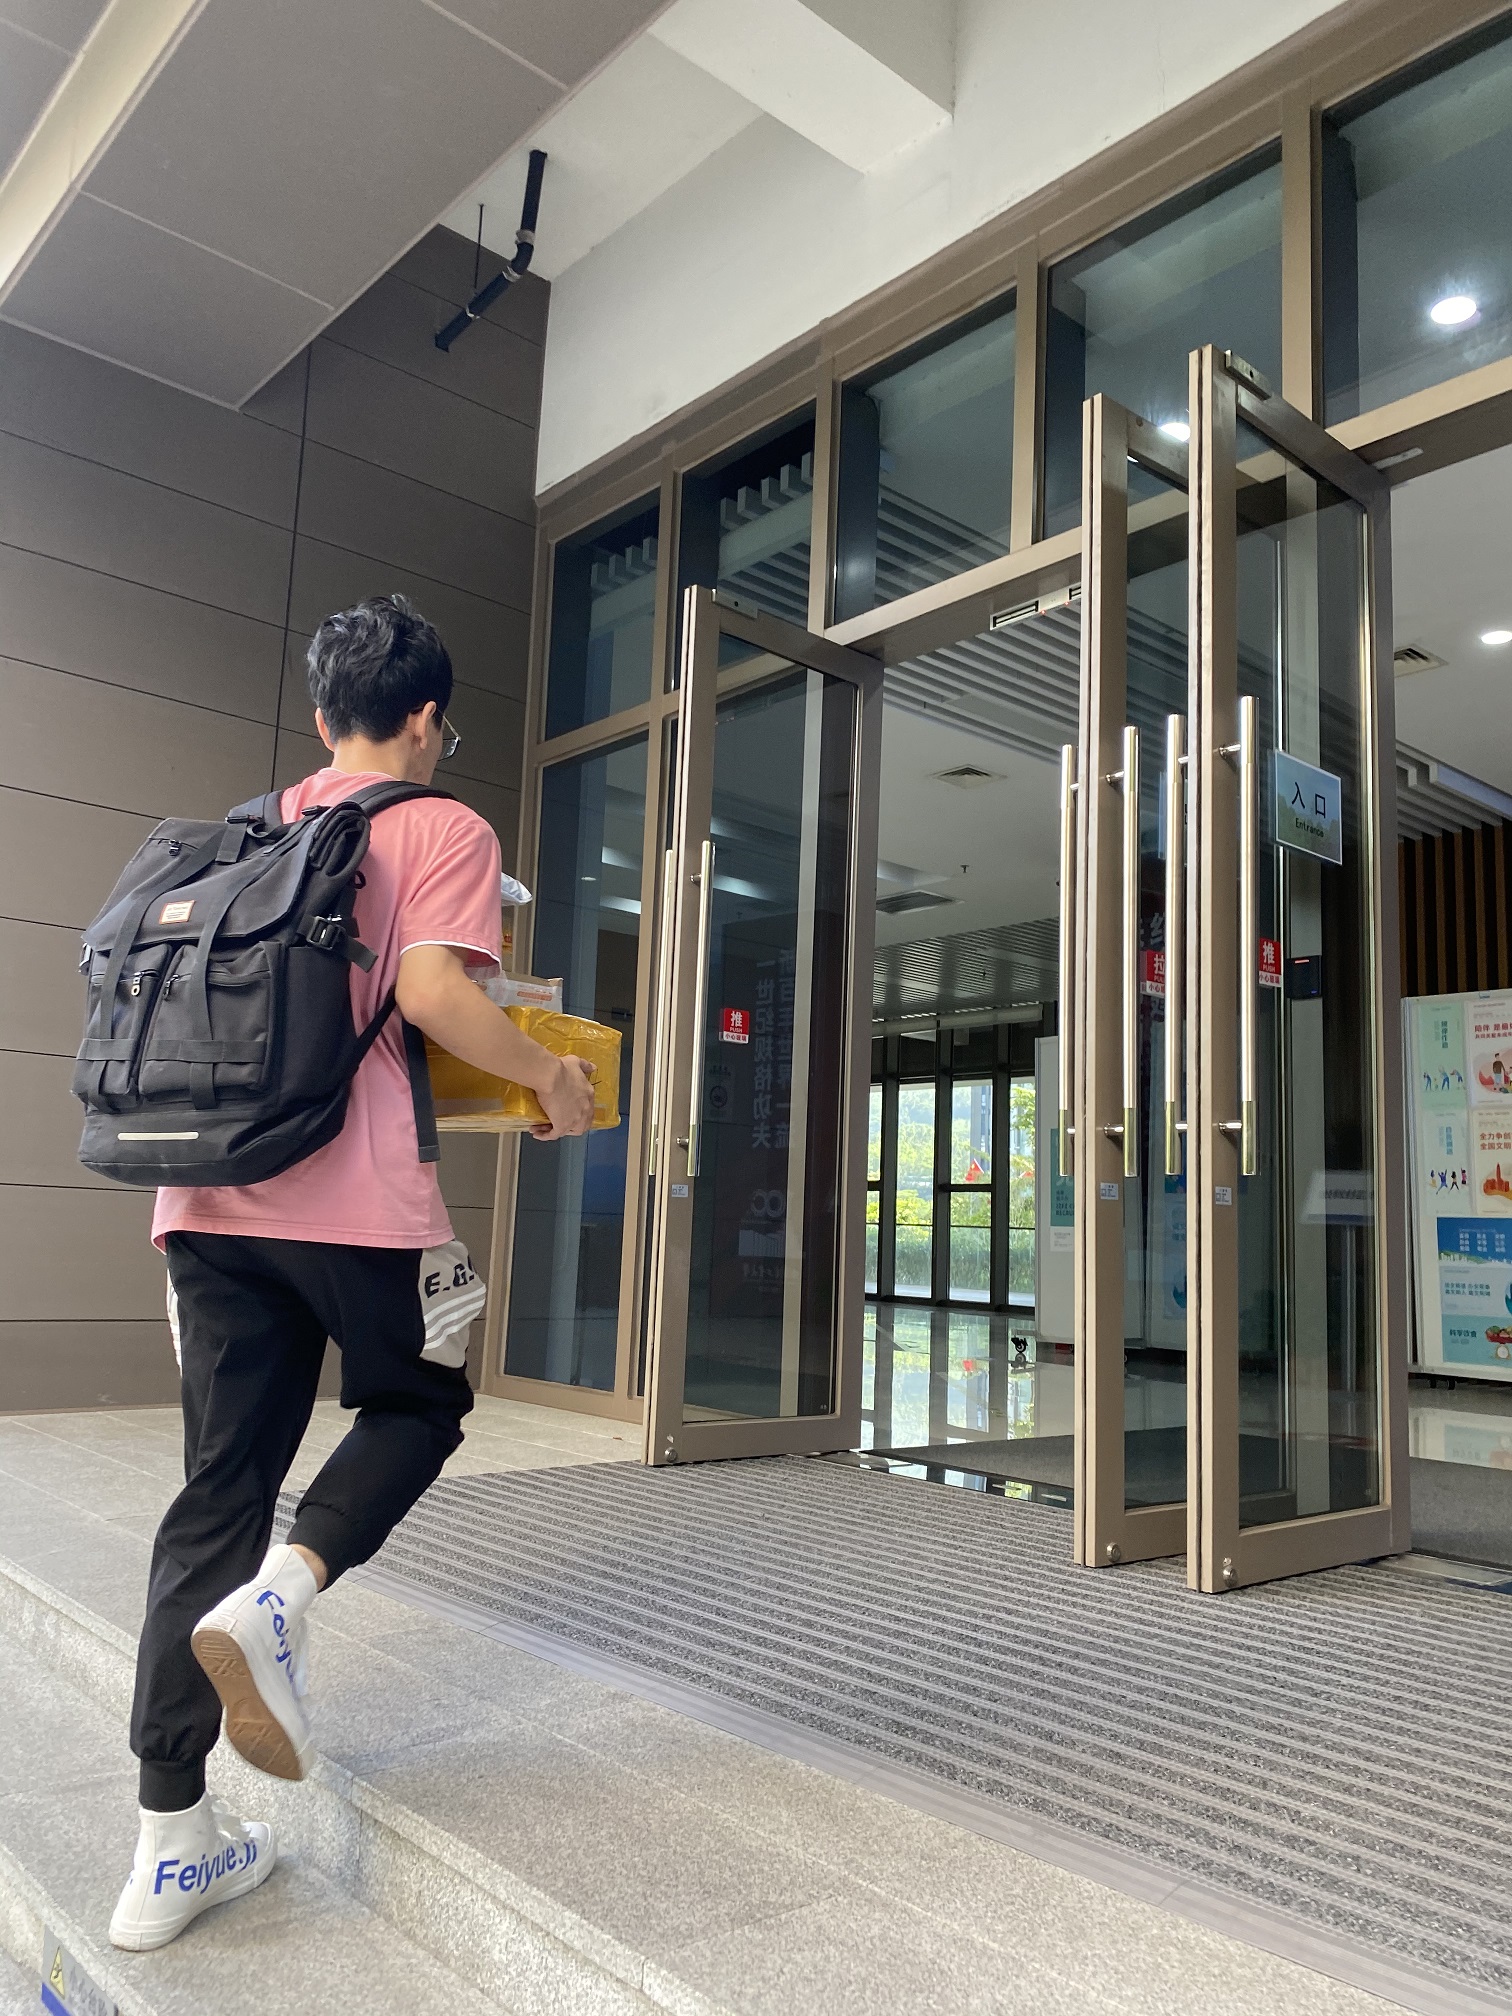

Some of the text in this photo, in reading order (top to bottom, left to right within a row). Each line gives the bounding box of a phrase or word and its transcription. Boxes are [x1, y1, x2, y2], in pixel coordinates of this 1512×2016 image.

[1291, 781, 1326, 819] 入口
[1295, 817, 1325, 838] Entrance
[1262, 940, 1276, 965] 推
[1262, 963, 1276, 973] PUSH
[730, 1010, 743, 1027] 推
[729, 1026, 743, 1034] PUSH
